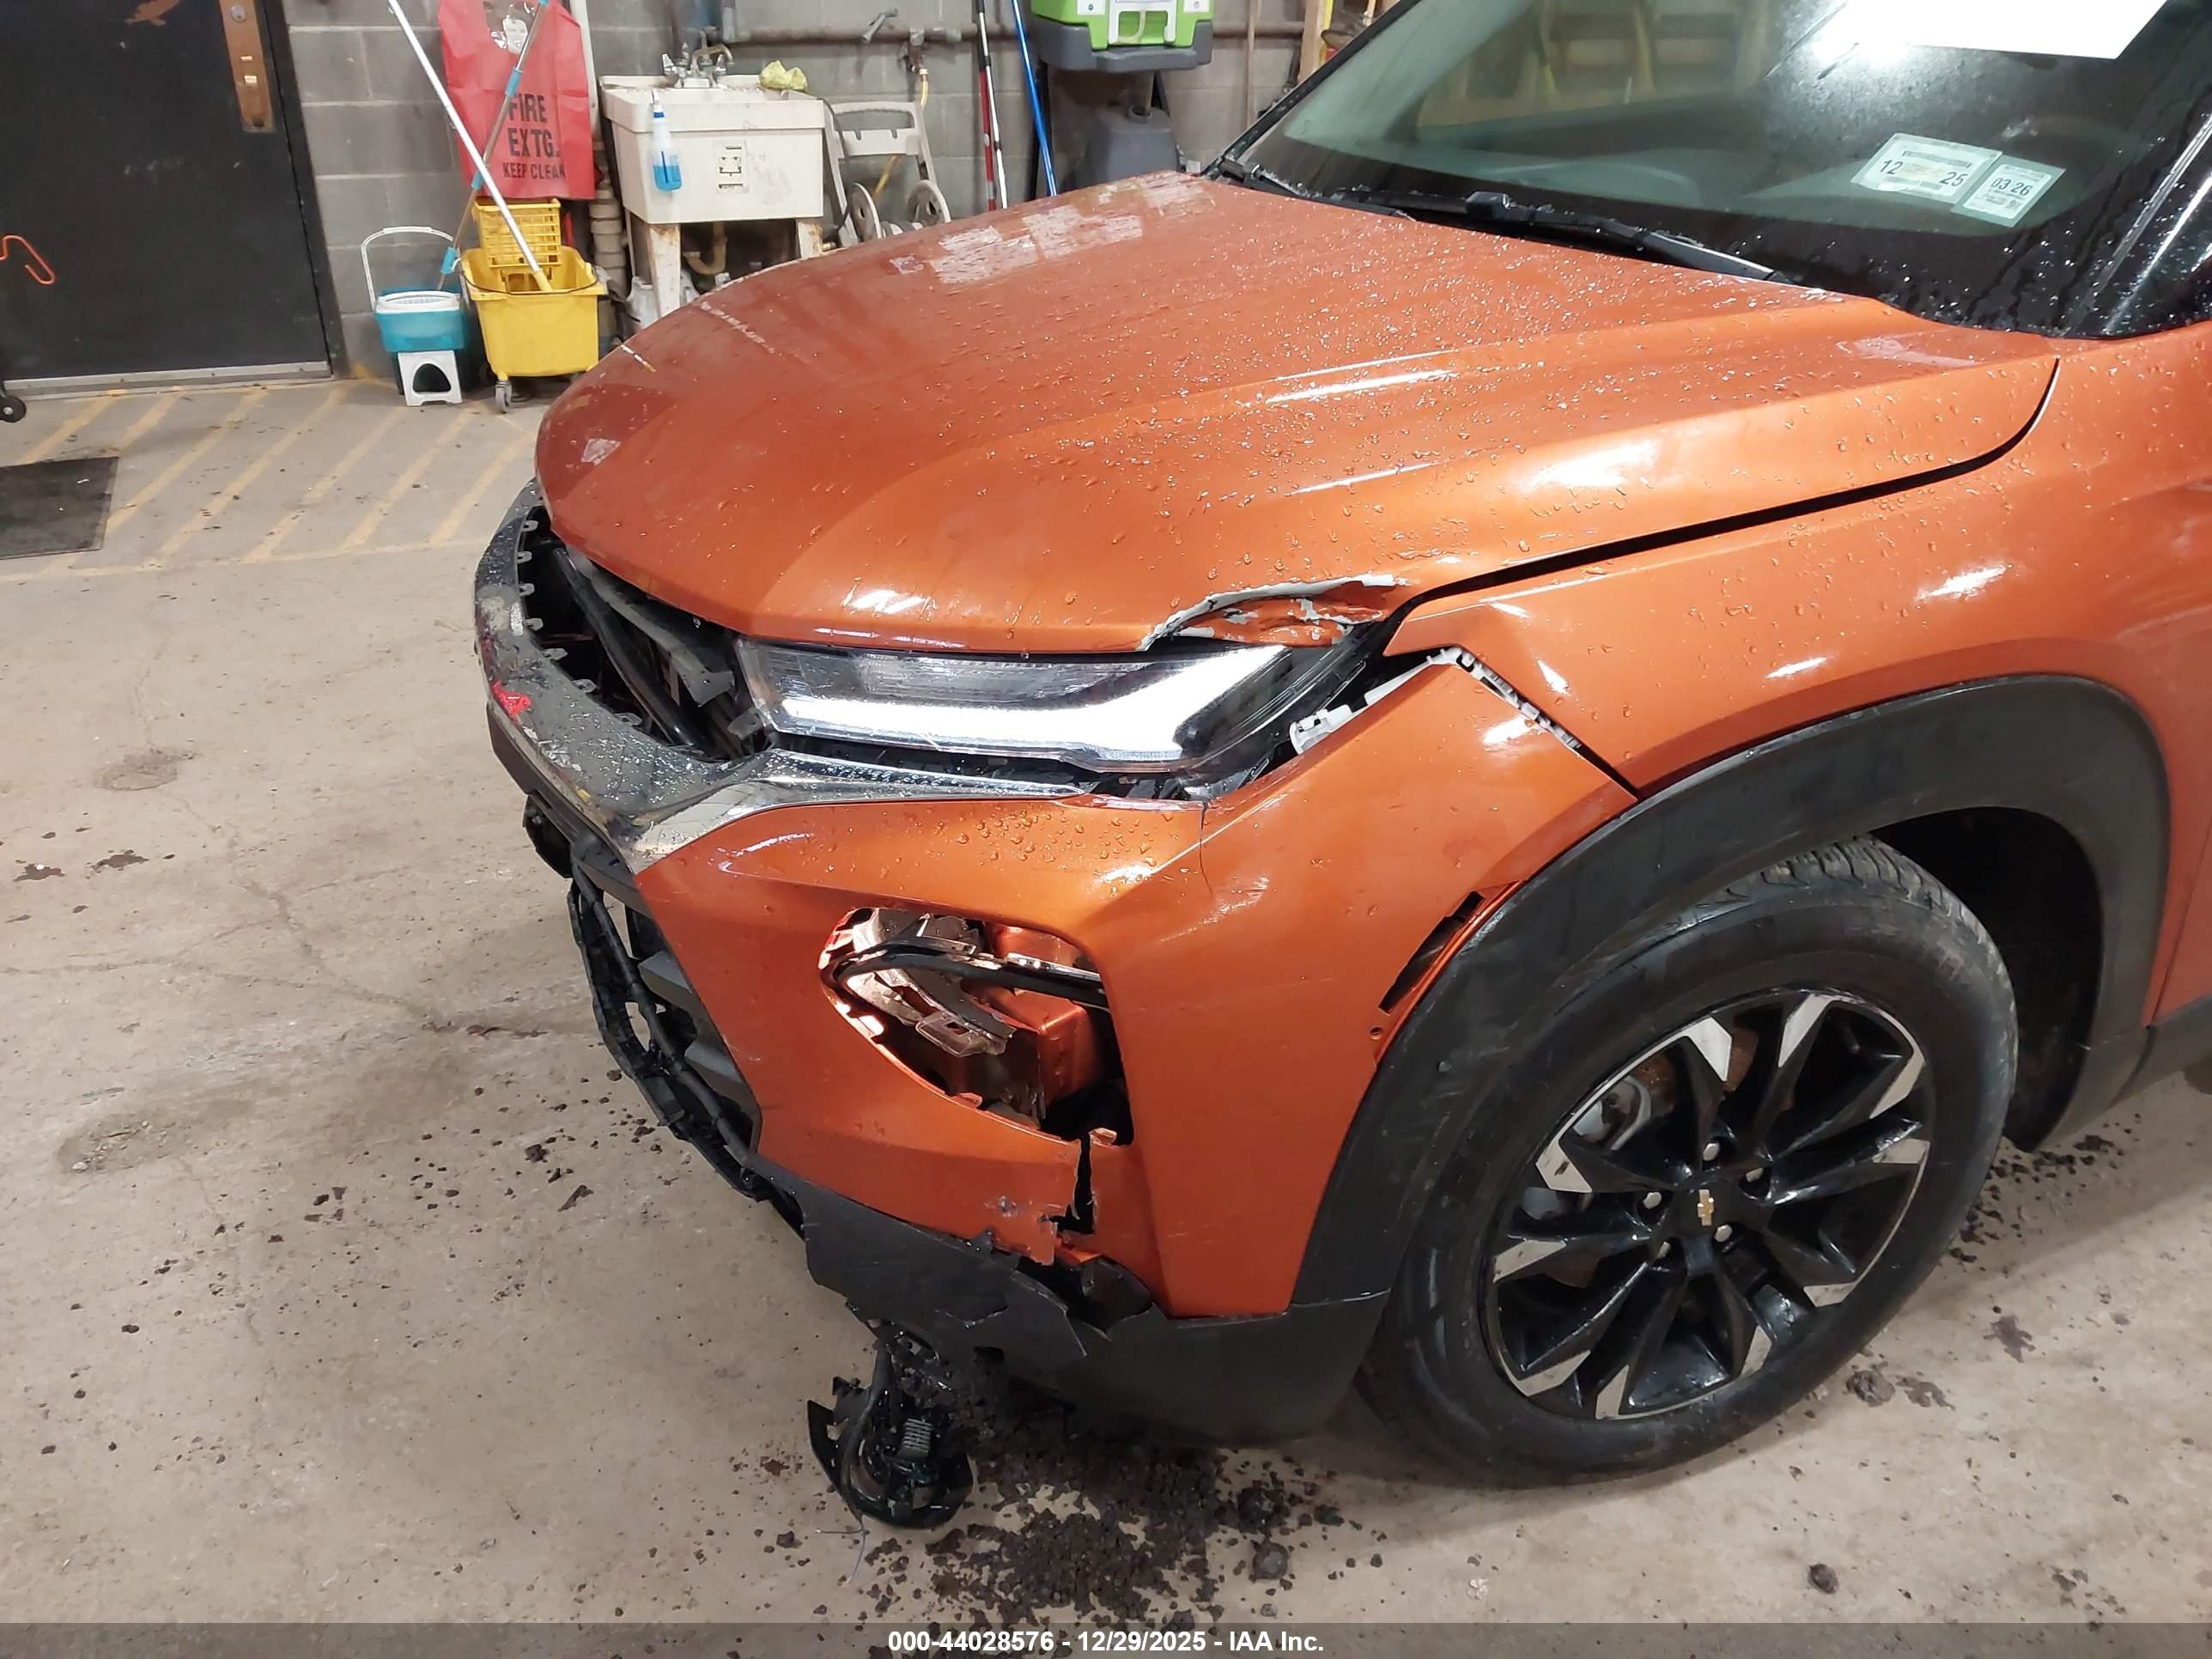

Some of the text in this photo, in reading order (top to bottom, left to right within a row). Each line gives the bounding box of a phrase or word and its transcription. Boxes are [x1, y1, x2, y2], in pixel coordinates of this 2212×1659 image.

[508, 94, 547, 123] FIRE
[507, 128, 560, 157] EXTG.
[503, 162, 526, 179] KEEP
[1881, 160, 1903, 175] 12
[1940, 172, 1968, 186] 25
[1991, 178, 2033, 196] 03 26
